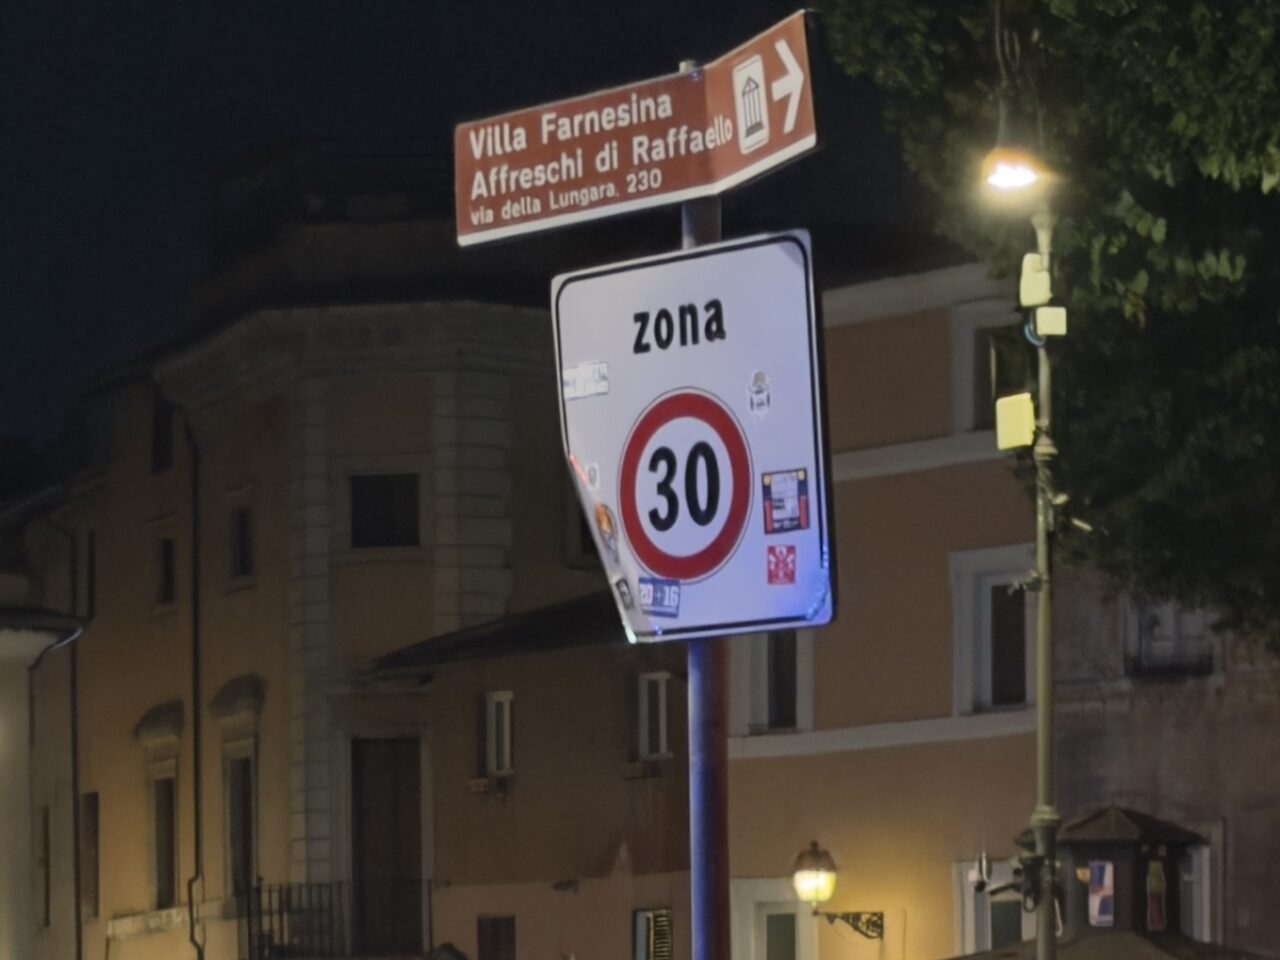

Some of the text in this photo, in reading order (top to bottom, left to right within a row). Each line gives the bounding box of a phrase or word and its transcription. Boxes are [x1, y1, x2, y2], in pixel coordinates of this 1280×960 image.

[469, 93, 673, 160] Villa Farnesina
[470, 115, 734, 201] Affreschi di Raffaello
[501, 195, 541, 220] della
[626, 168, 662, 193] 230
[632, 297, 727, 354] zona
[648, 440, 721, 532] 30
